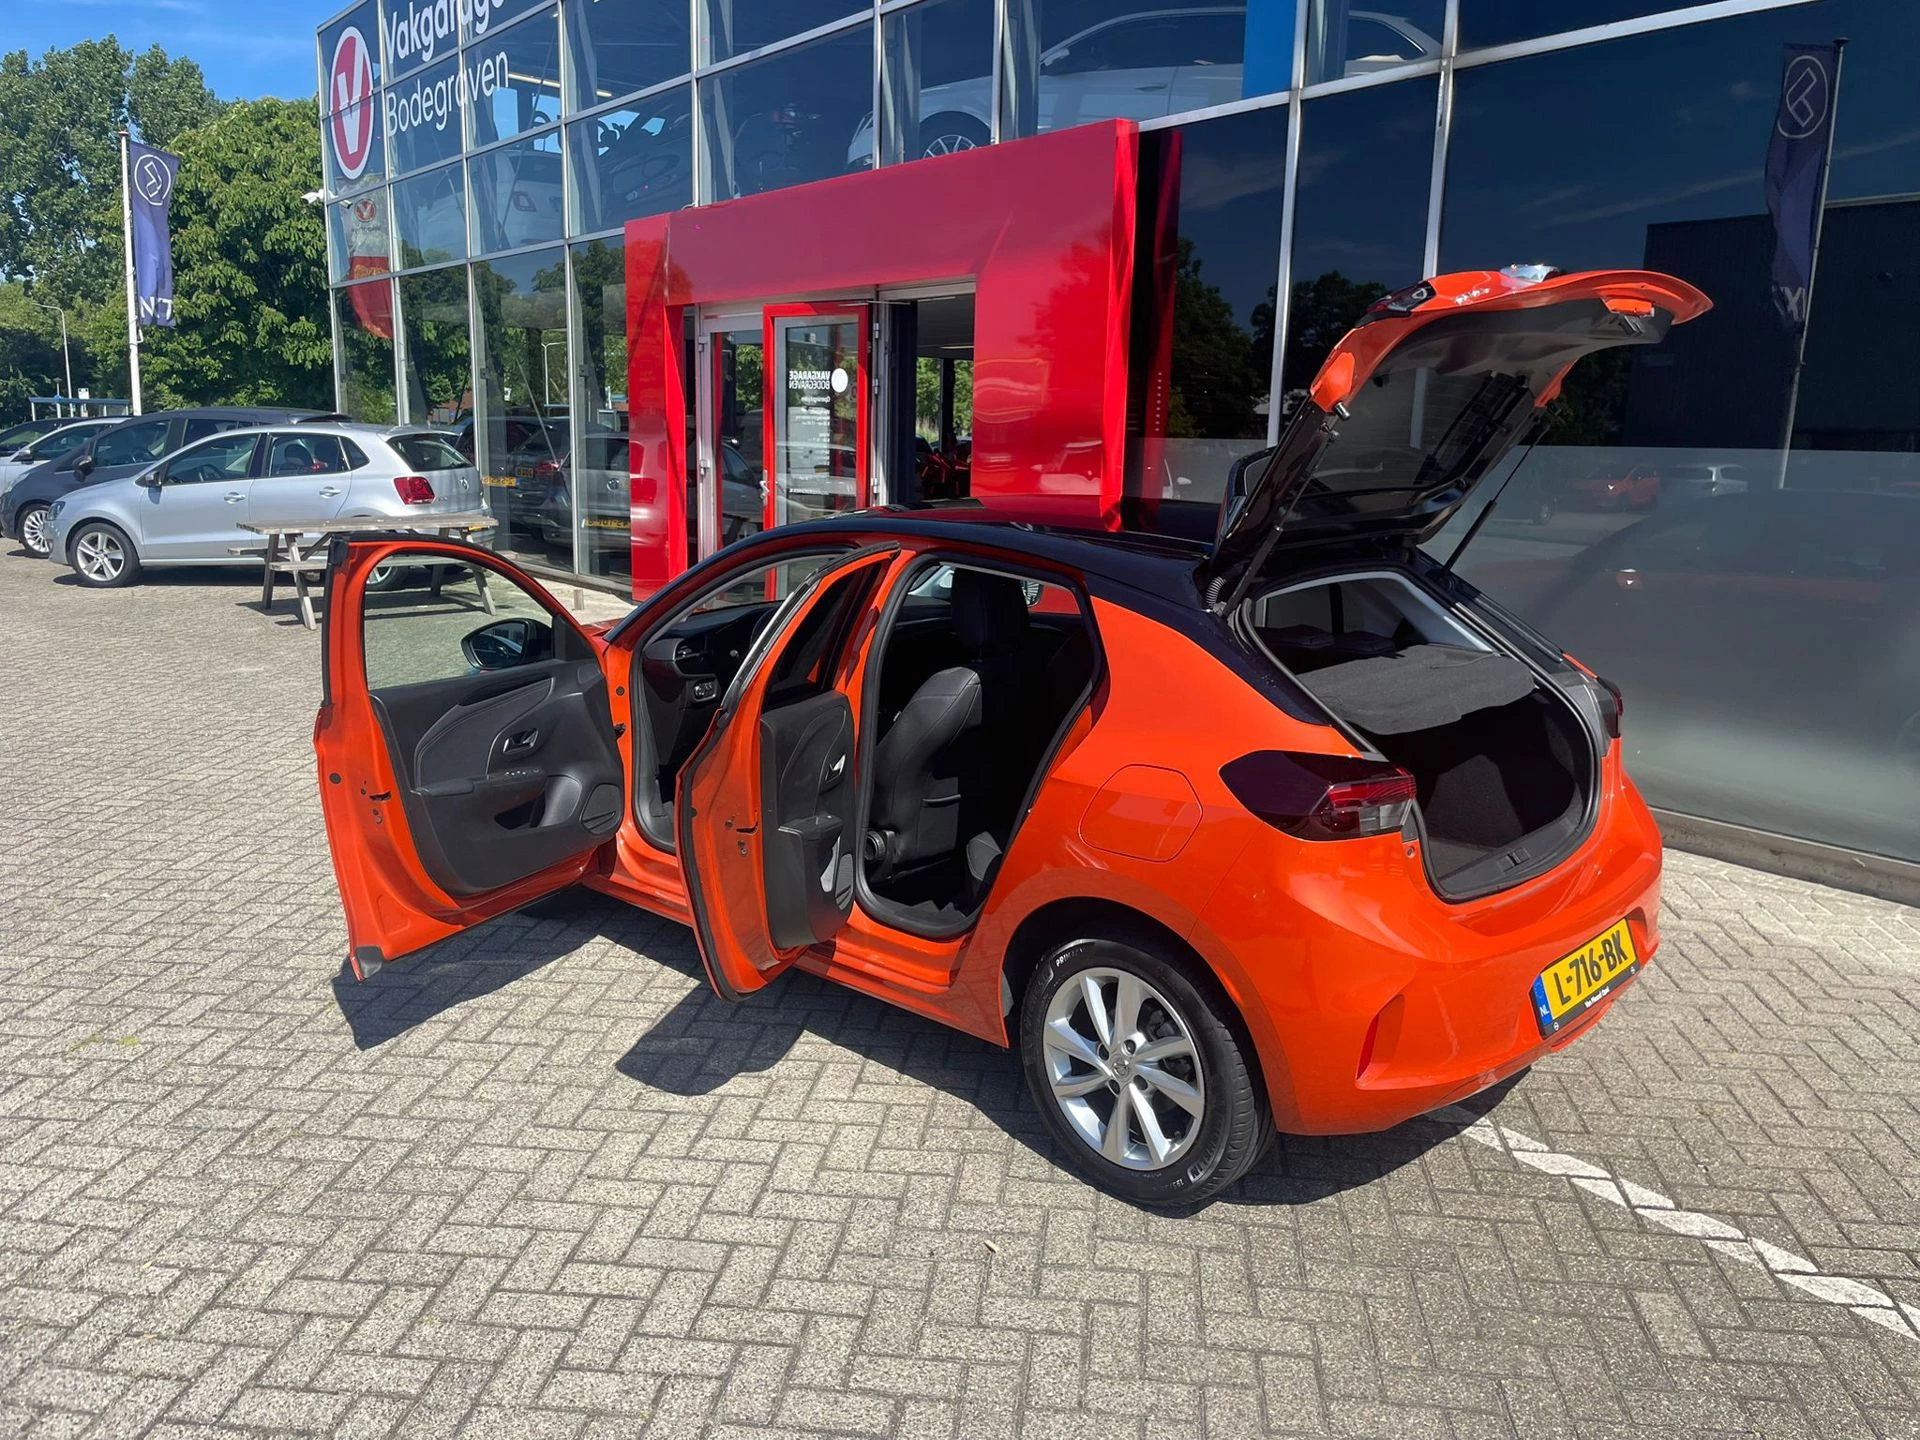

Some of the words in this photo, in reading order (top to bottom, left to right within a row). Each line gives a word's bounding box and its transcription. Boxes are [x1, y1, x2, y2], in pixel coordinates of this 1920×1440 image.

[384, 0, 503, 64] Vakgarag
[387, 51, 509, 137] Bodegraven
[1553, 930, 1628, 1006] L-716-BK
[1539, 1004, 1550, 1017] NL
